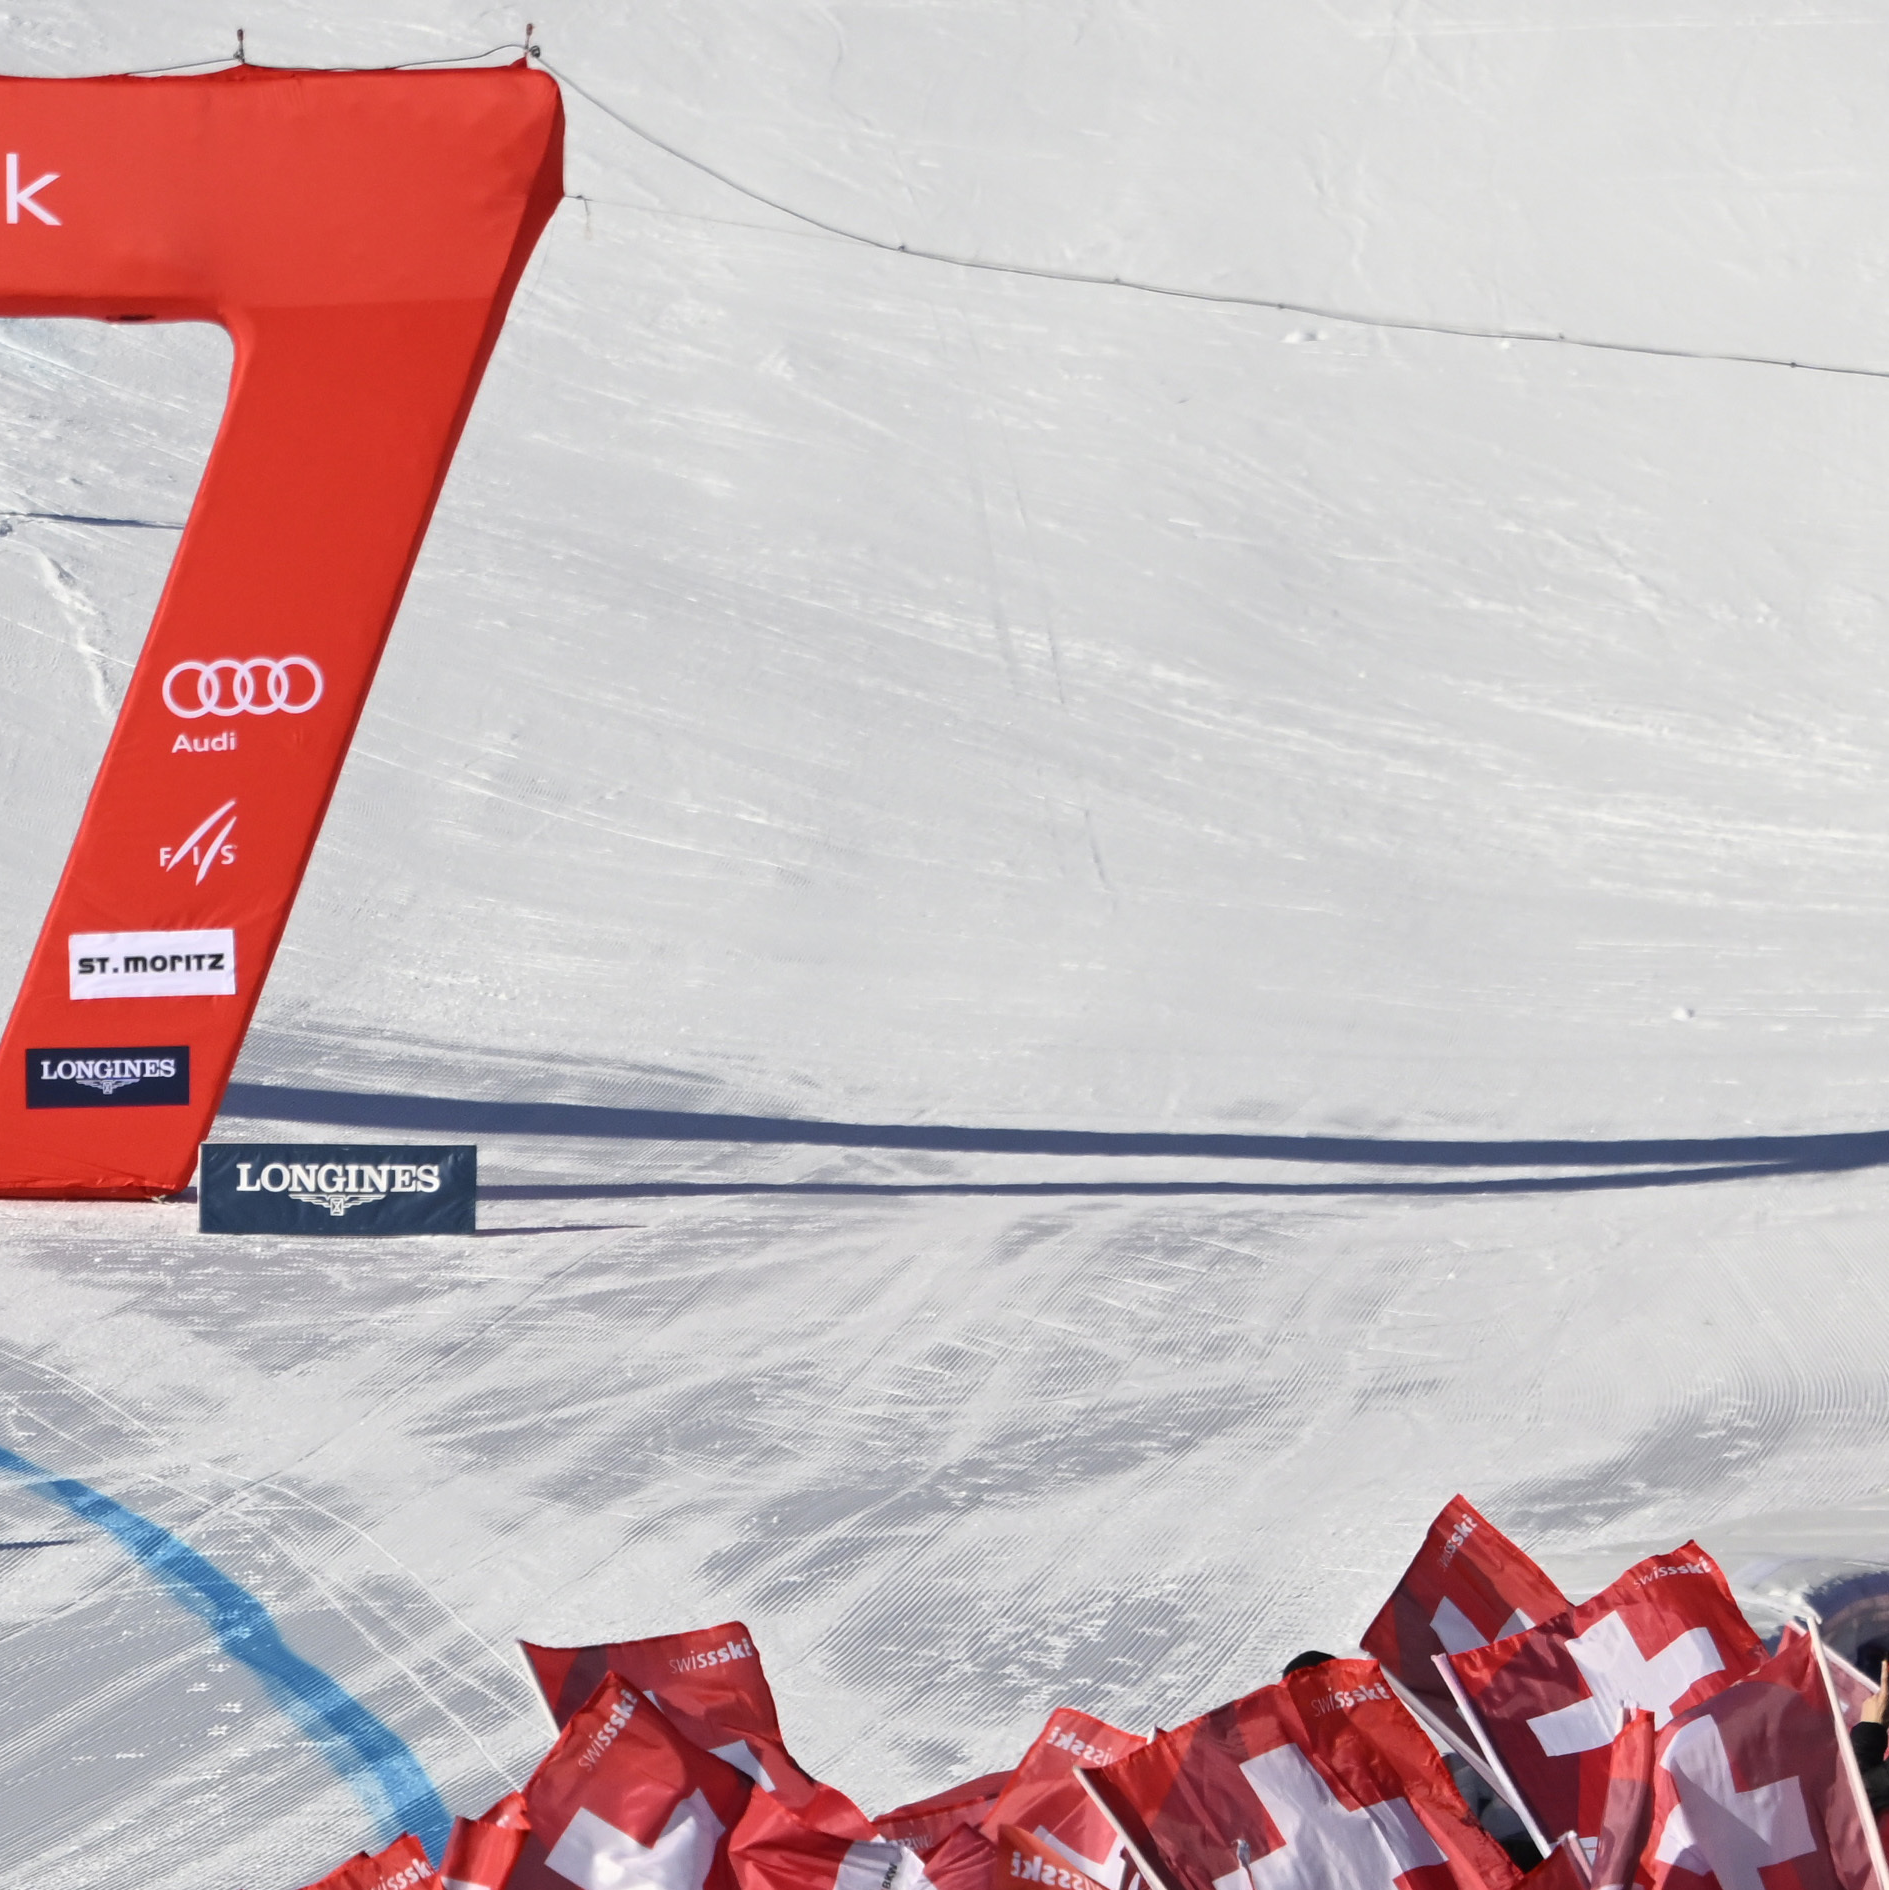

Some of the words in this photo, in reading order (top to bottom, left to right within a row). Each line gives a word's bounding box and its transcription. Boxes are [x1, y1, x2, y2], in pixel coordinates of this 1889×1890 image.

[171, 732, 237, 753] Audi
[41, 1059, 176, 1081] LONGINES
[236, 1163, 441, 1194] LONGINES
[1633, 1556, 1713, 1591] swissski
[669, 1638, 753, 1675] swissski
[577, 1688, 638, 1772] swissski
[882, 1863, 898, 1890] BKW
